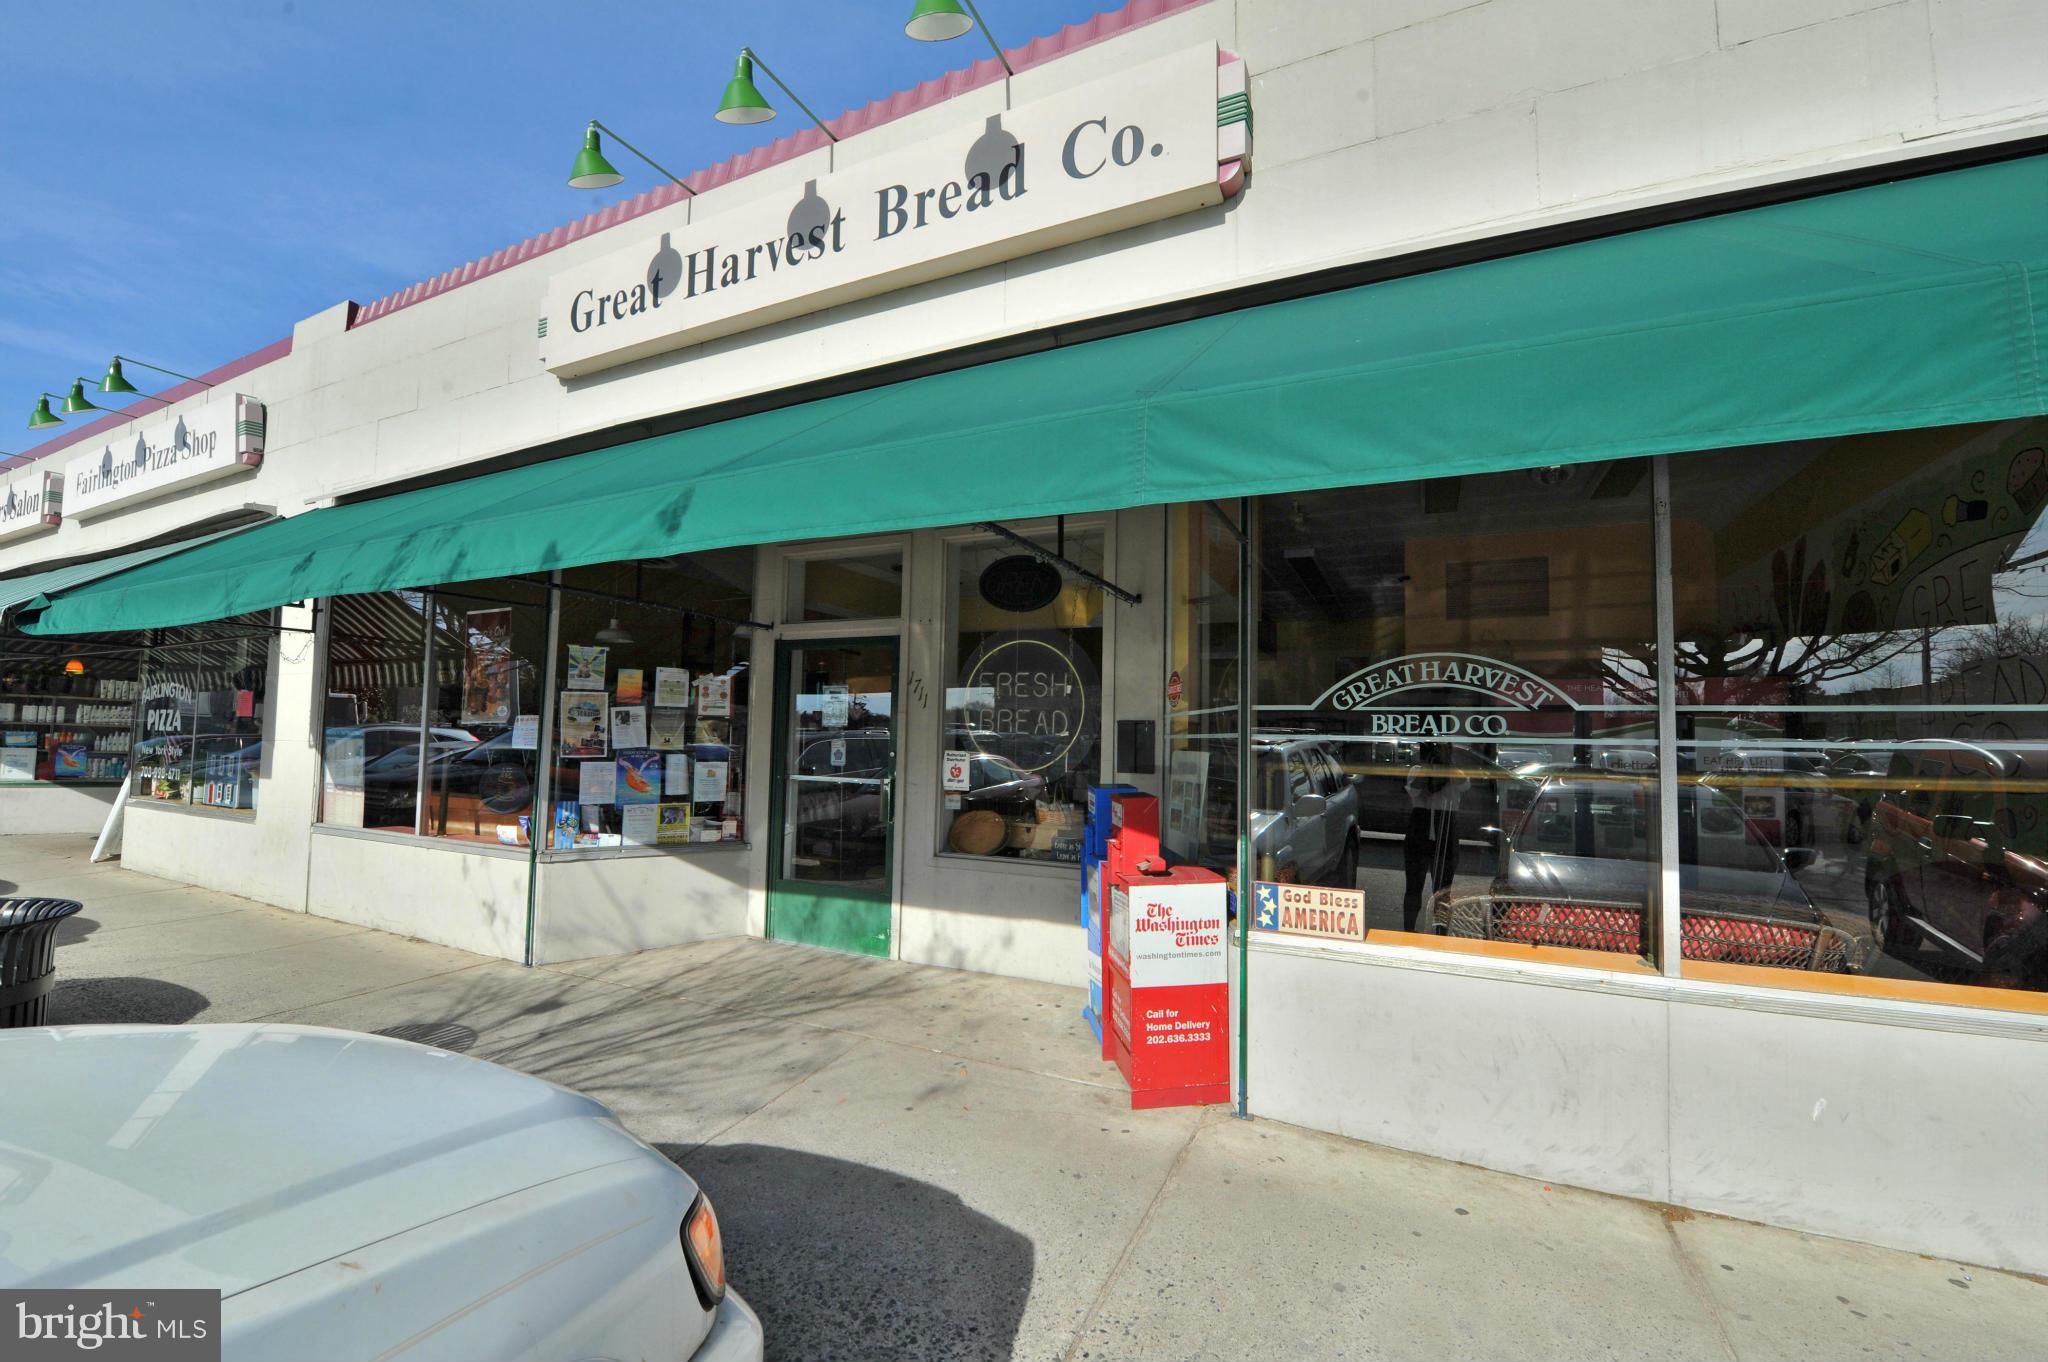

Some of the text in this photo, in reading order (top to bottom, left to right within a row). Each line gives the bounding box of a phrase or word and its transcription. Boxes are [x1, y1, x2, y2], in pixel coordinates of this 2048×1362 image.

[570, 115, 1165, 333] Great Harvest Bread Co.
[76, 429, 217, 497] Fairlington Pizza Shop
[10, 490, 39, 519] Salon
[142, 682, 192, 704] FAIRLINGTON
[907, 671, 928, 709] 1711
[979, 672, 1069, 698] FRESH
[1332, 661, 1553, 711] GREAT HARVEST
[147, 709, 181, 731] PIZZA
[980, 709, 1069, 735] BREAD
[1371, 714, 1511, 736] BREAD CO.
[142, 745, 154, 754] New
[168, 746, 182, 758] Style
[1283, 889, 1358, 908] God Bless
[1146, 903, 1173, 920] The
[1281, 906, 1359, 936] AMERICA
[1135, 917, 1220, 934] Washington
[1175, 931, 1219, 947] Times
[1136, 949, 1221, 961] washingtontimes.com
[1146, 1008, 1178, 1019] Call for
[1146, 1020, 1211, 1031] Home Delivery
[1146, 1032, 1211, 1044] 202.636.3333
